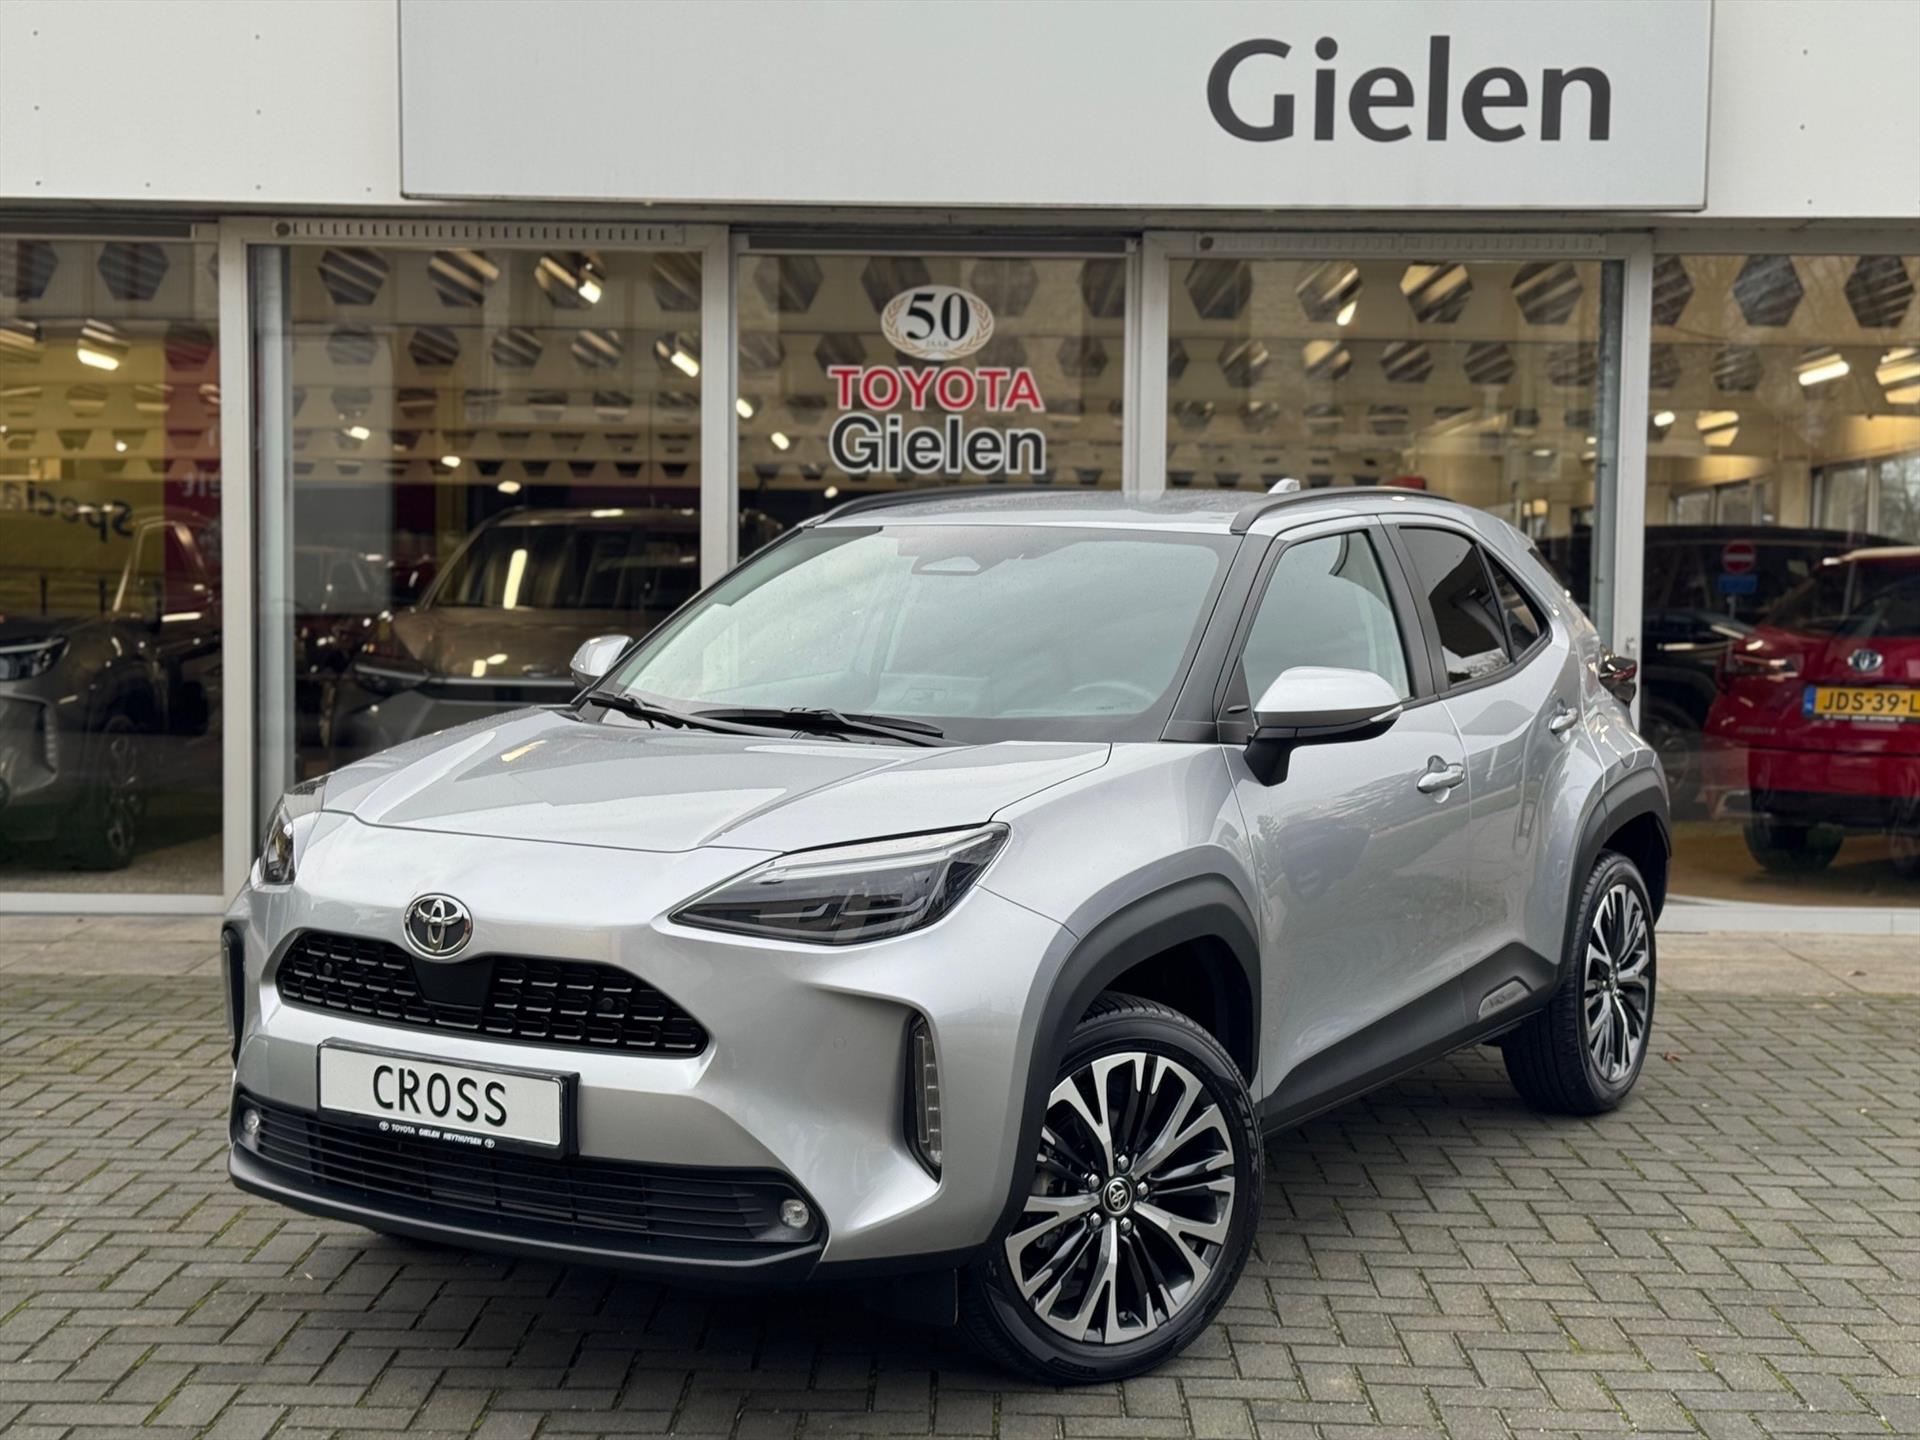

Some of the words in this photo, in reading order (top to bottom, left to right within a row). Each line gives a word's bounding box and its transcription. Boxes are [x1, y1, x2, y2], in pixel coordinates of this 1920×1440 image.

[1207, 35, 1612, 142] Gielen
[906, 292, 970, 341] 50
[828, 366, 1044, 411] TOYOTA
[830, 413, 1045, 473] Gielen
[373, 1064, 507, 1127] CROSS
[391, 1123, 416, 1135] TOYOTA
[418, 1128, 441, 1139] GIELEN
